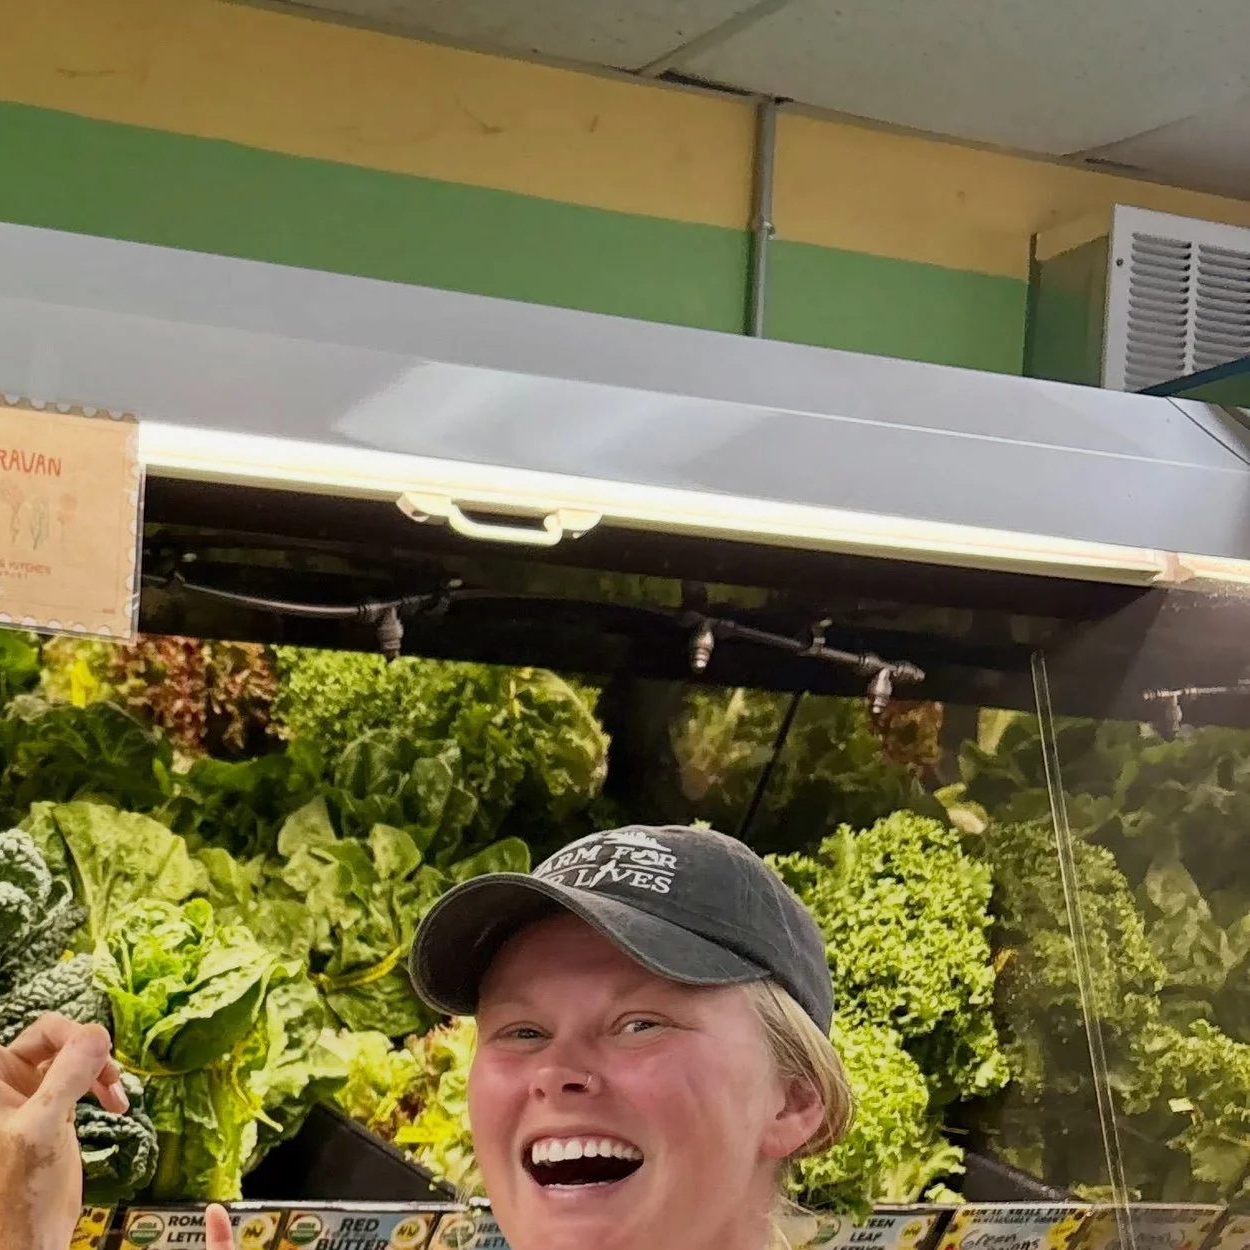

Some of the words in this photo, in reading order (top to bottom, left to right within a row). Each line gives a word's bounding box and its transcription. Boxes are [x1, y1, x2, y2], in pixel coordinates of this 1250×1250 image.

[534, 845, 602, 877] ARM
[339, 1217, 380, 1233] RED
[850, 1231, 884, 1242] LEAF
